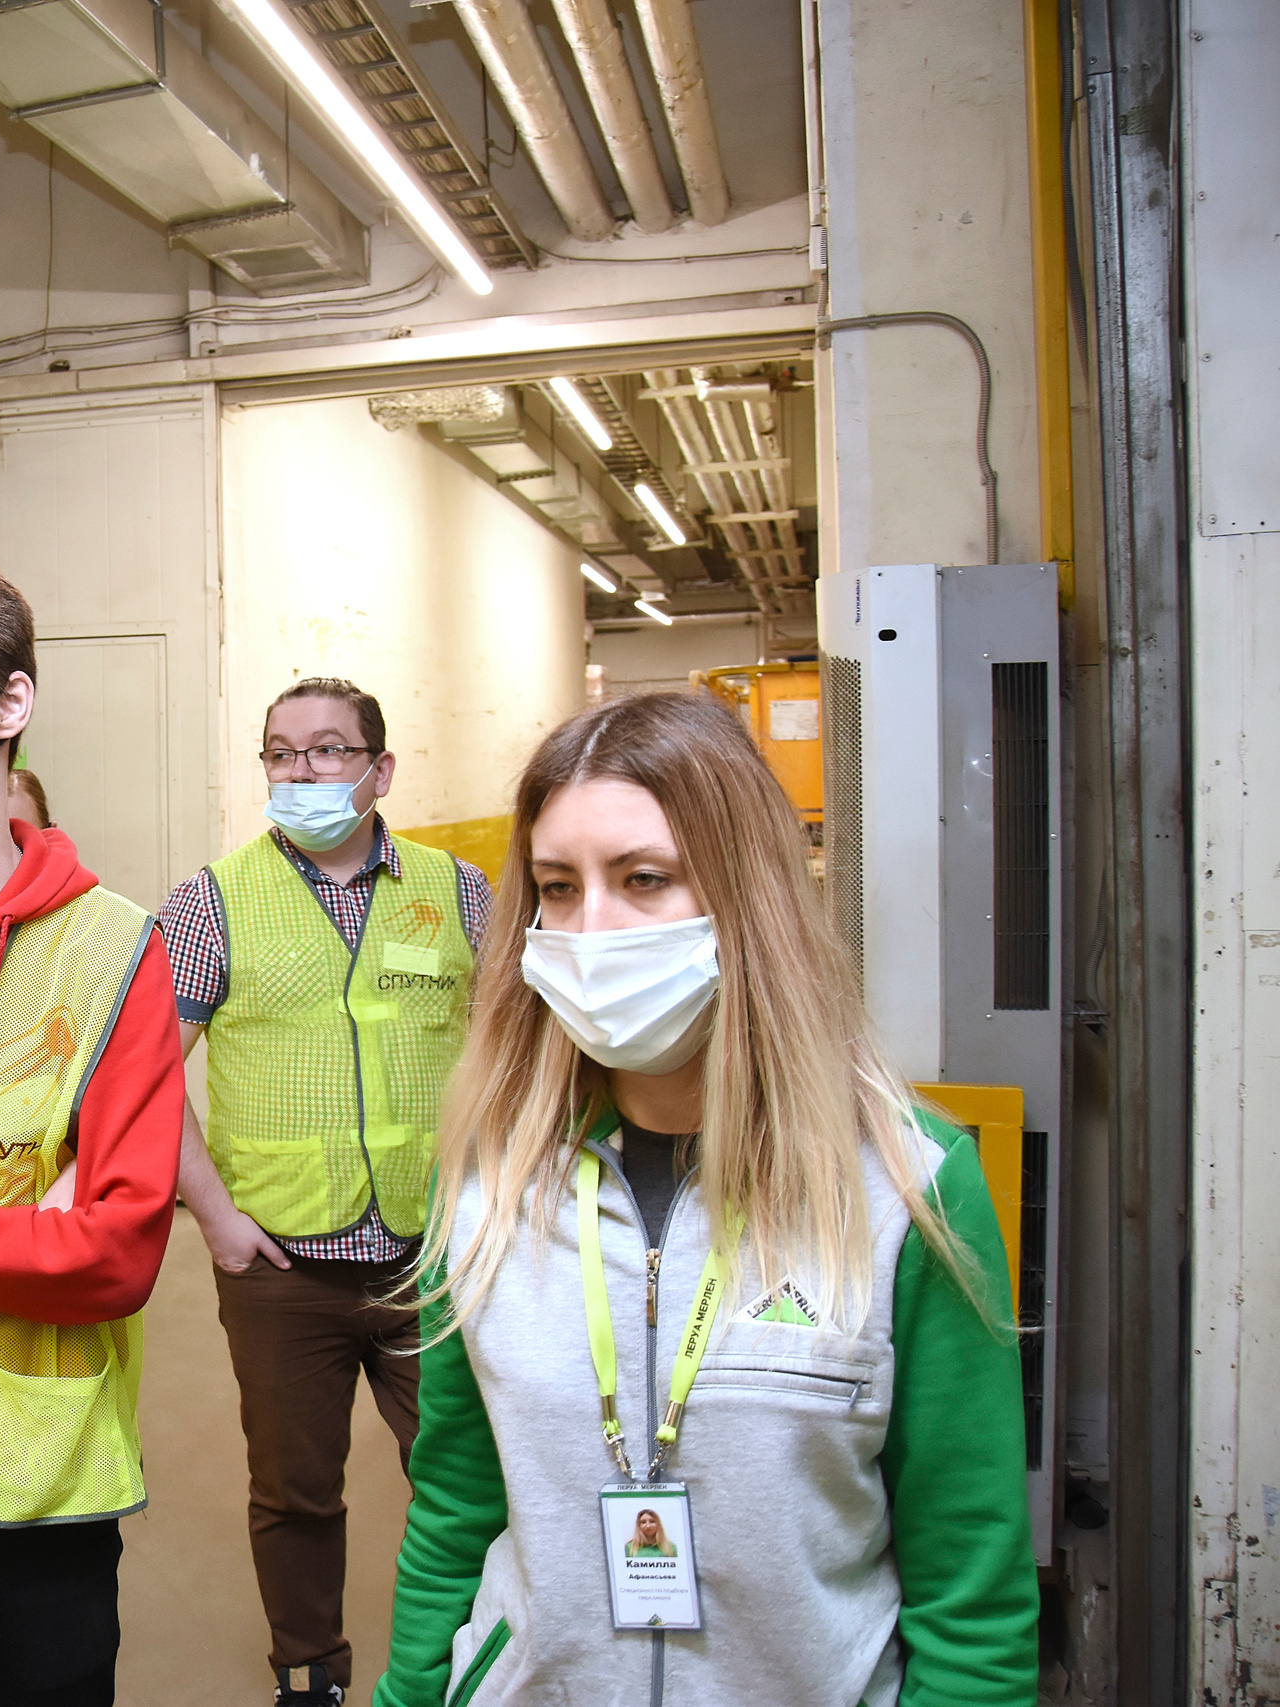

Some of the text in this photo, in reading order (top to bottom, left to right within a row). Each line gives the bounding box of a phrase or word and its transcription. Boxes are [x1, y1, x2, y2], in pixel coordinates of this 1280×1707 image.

[684, 1277, 718, 1359] ЛЕРУА МЕРЛЕН
[626, 1560, 677, 1568] Камилла
[628, 1573, 677, 1581] Афанасьева
